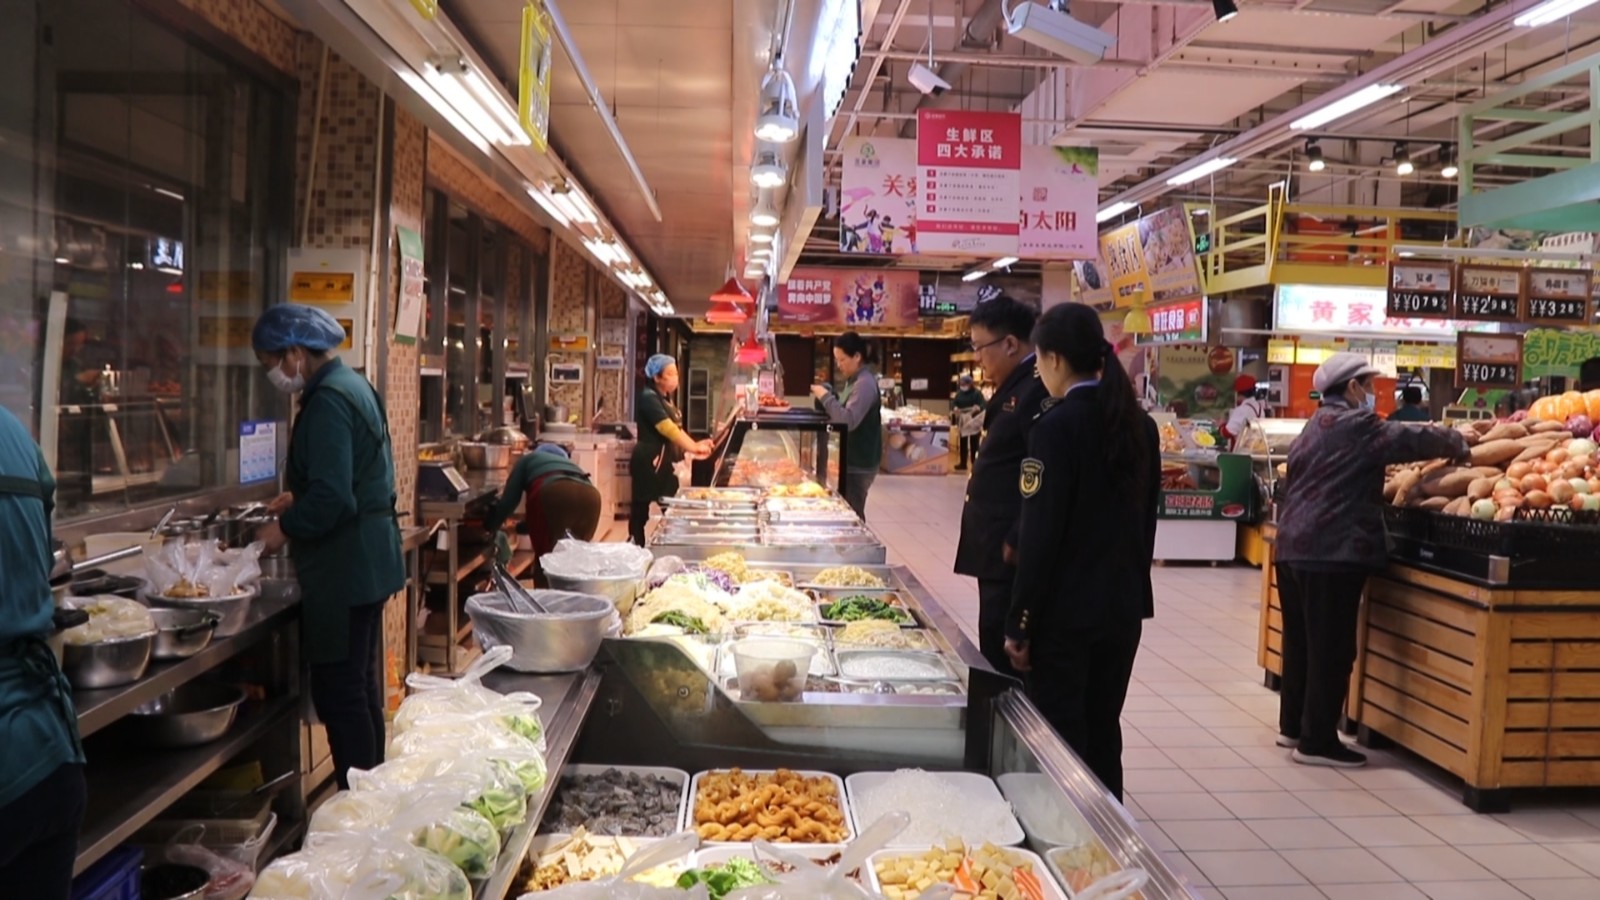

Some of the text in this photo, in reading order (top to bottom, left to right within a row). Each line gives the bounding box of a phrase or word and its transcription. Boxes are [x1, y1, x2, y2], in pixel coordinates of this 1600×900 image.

[946, 127, 994, 143] 生鲜区
[937, 143, 1002, 160] 四大承诺
